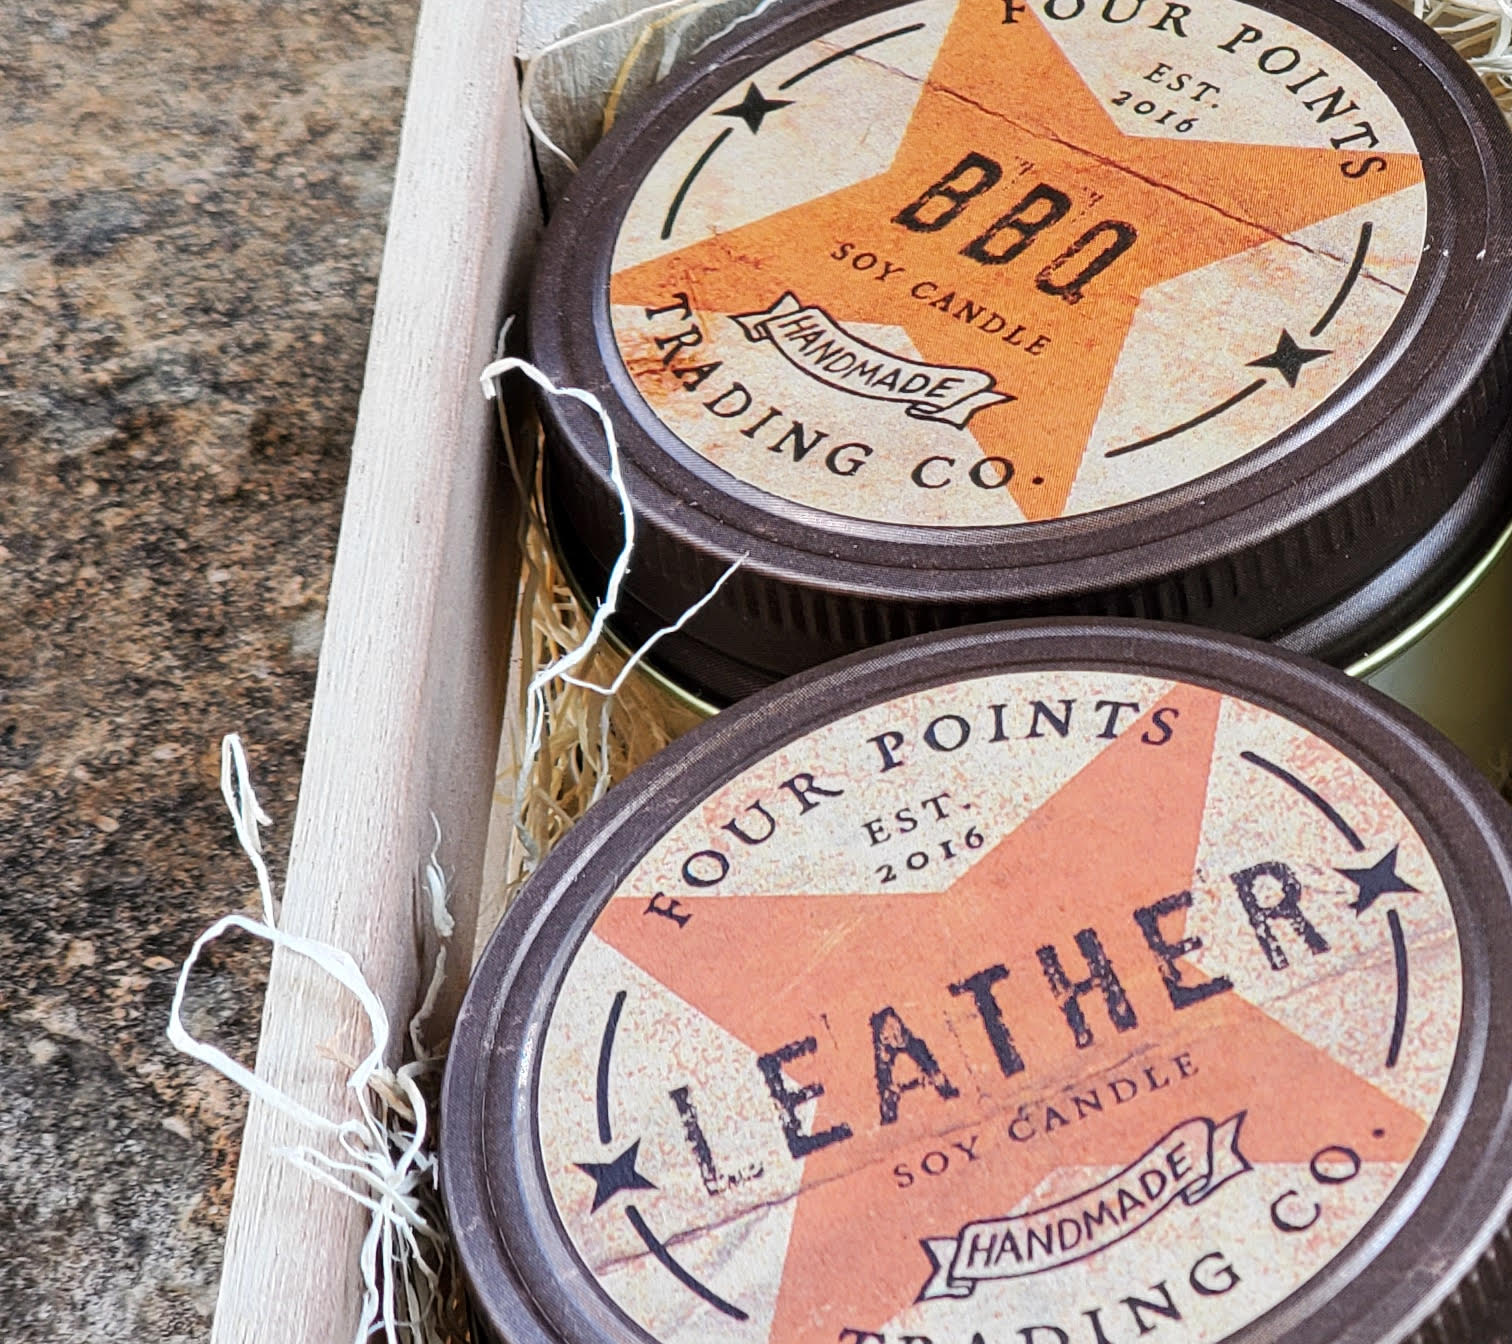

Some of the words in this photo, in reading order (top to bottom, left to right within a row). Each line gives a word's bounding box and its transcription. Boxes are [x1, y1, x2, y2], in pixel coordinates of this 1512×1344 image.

[1111, 88, 1196, 135] 2016
[1144, 61, 1220, 109] EST.
[1218, 32, 1389, 180] POINTS
[890, 150, 1139, 306] BBQ
[782, 309, 963, 403] HANDMADE
[830, 239, 900, 286] SOY
[910, 277, 1052, 359] CANDLE
[643, 291, 873, 478] TRADING
[644, 769, 845, 929] FOUR
[868, 699, 1182, 772] POINTS
[861, 790, 974, 846] EST.
[875, 827, 986, 884] 2016
[669, 858, 1332, 1194] LEATHER
[891, 1132, 981, 1190] SOY
[1007, 1052, 1203, 1144] CANDLE
[962, 1142, 1194, 1267] HANDMADE
